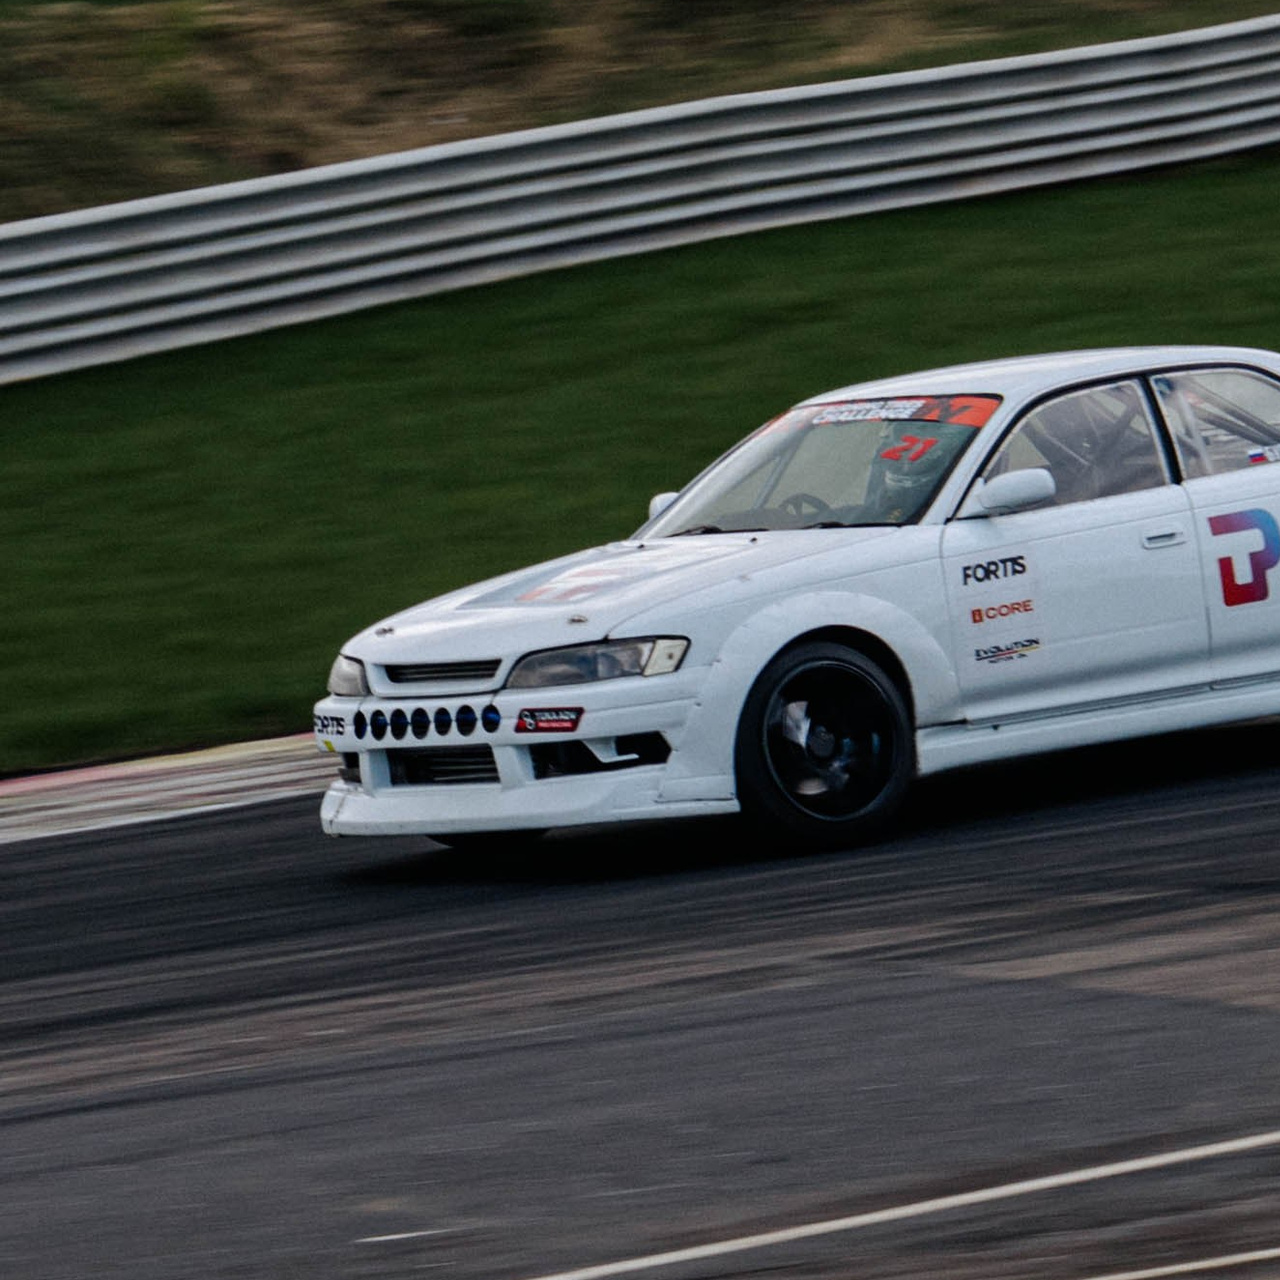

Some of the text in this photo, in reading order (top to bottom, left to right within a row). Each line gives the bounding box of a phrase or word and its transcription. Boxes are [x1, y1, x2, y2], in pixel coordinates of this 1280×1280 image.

[881, 435, 938, 462] 21
[963, 555, 1026, 586] FORTIS
[985, 600, 1033, 619] CORE
